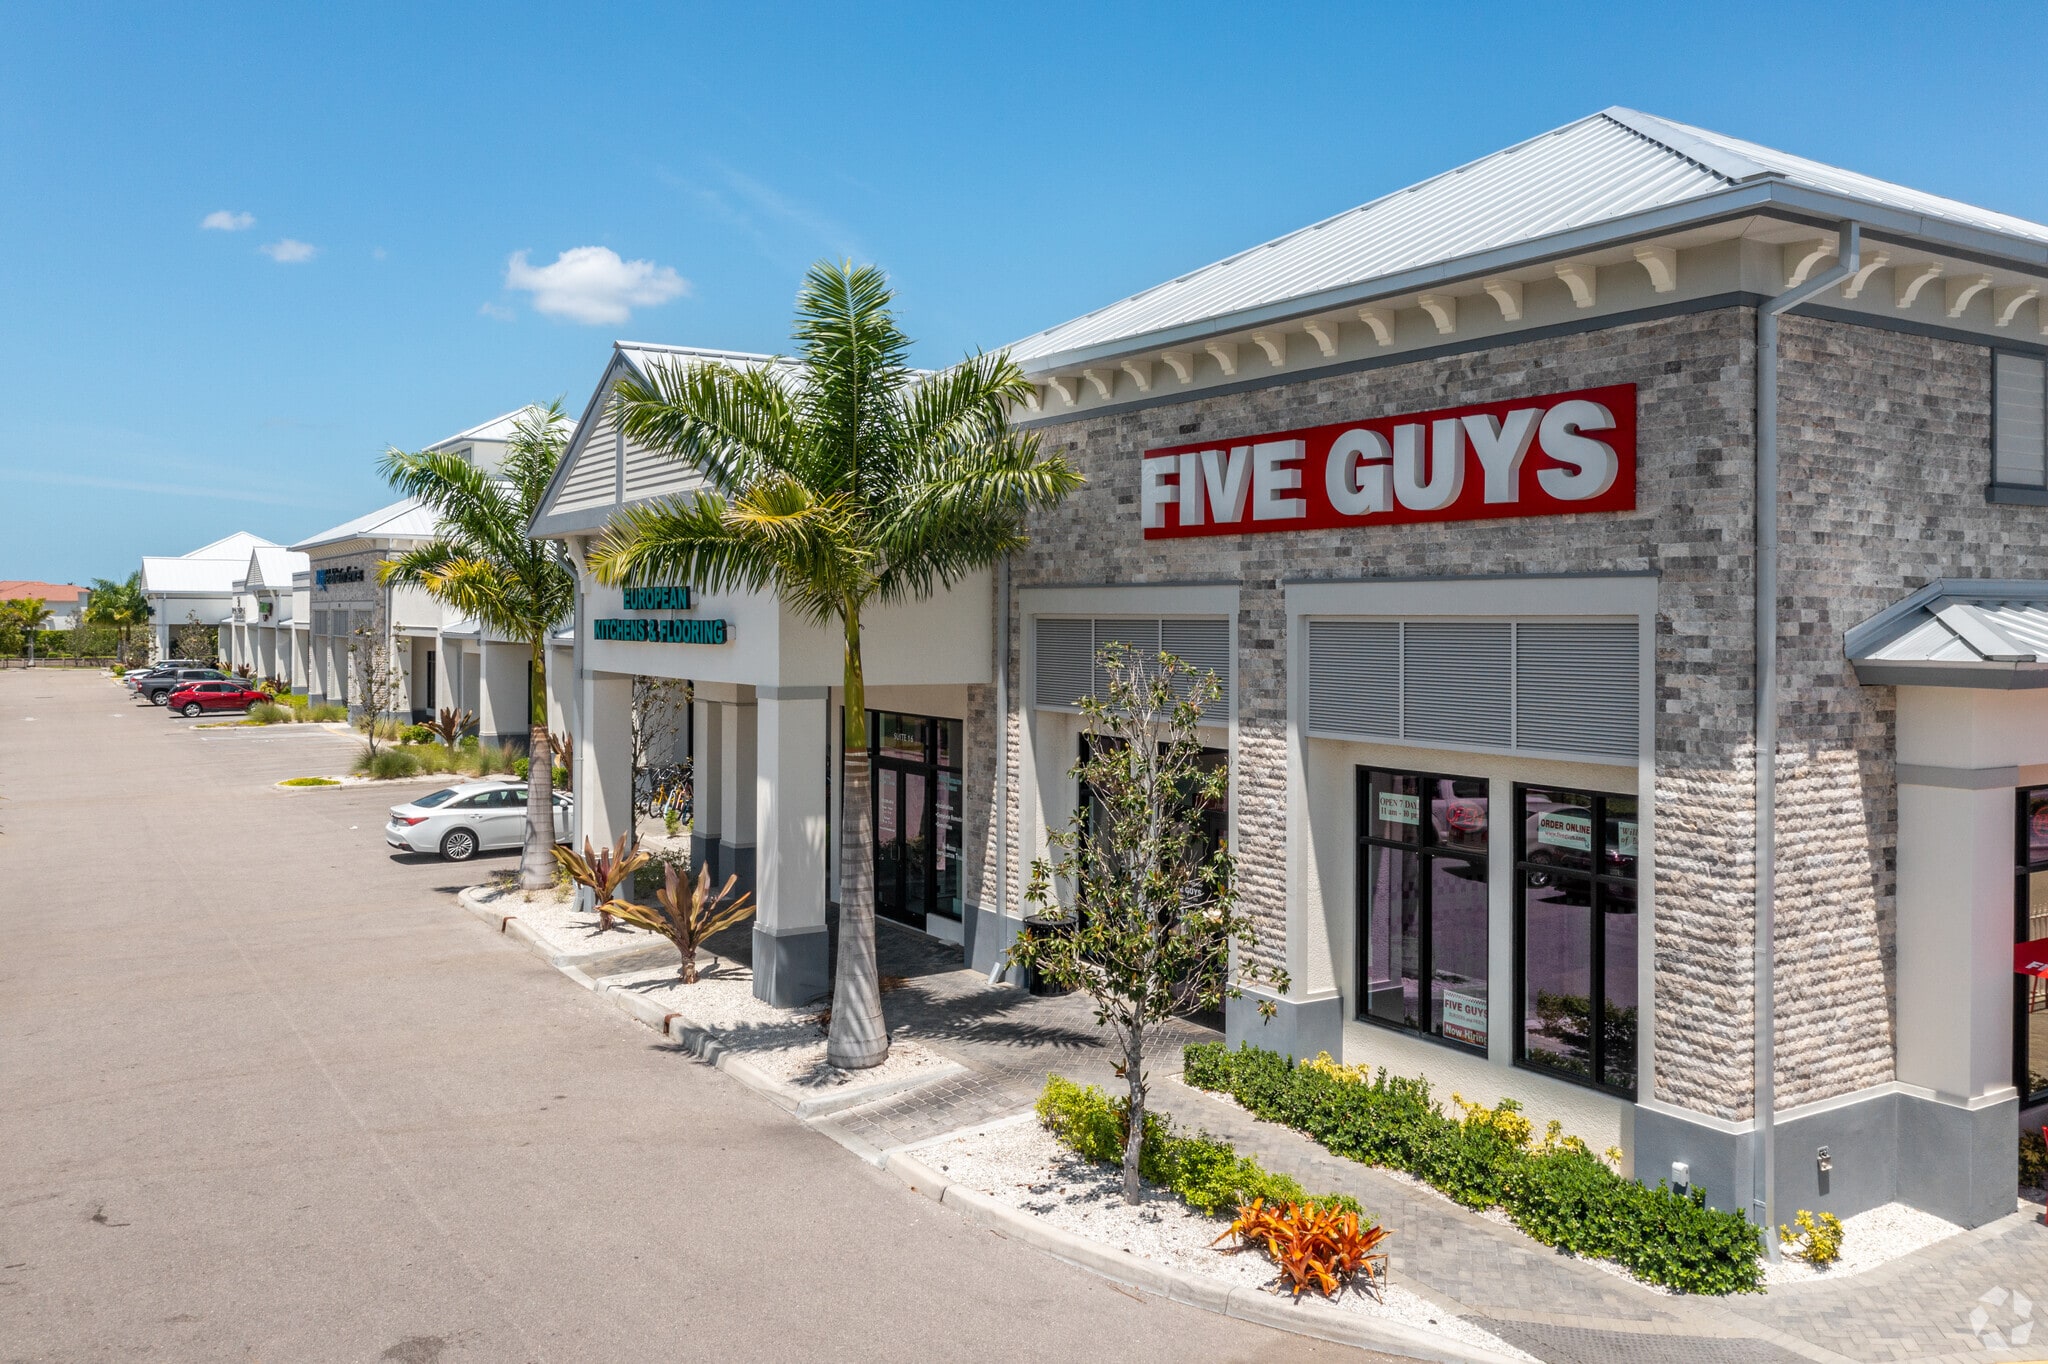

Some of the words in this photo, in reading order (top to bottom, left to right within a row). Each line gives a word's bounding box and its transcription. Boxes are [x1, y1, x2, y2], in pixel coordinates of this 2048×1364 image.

[1141, 439, 1306, 529] FIVE
[1325, 400, 1619, 516] GUYS
[623, 587, 690, 610] EUROPEAN
[594, 619, 647, 642] KITCHENS
[648, 619, 658, 642] &
[660, 620, 727, 645] FLOORING
[1380, 797, 1398, 807] OPEN
[1405, 800, 1418, 809] DAY
[1388, 809, 1398, 817] am
[1447, 805, 1483, 825] OPEN
[1541, 819, 1563, 830] ORDER
[1566, 823, 1591, 834] ONLINE
[1445, 1000, 1462, 1011] FIVE
[1465, 1005, 1487, 1018] GUYS
[1446, 1024, 1462, 1037] Now
